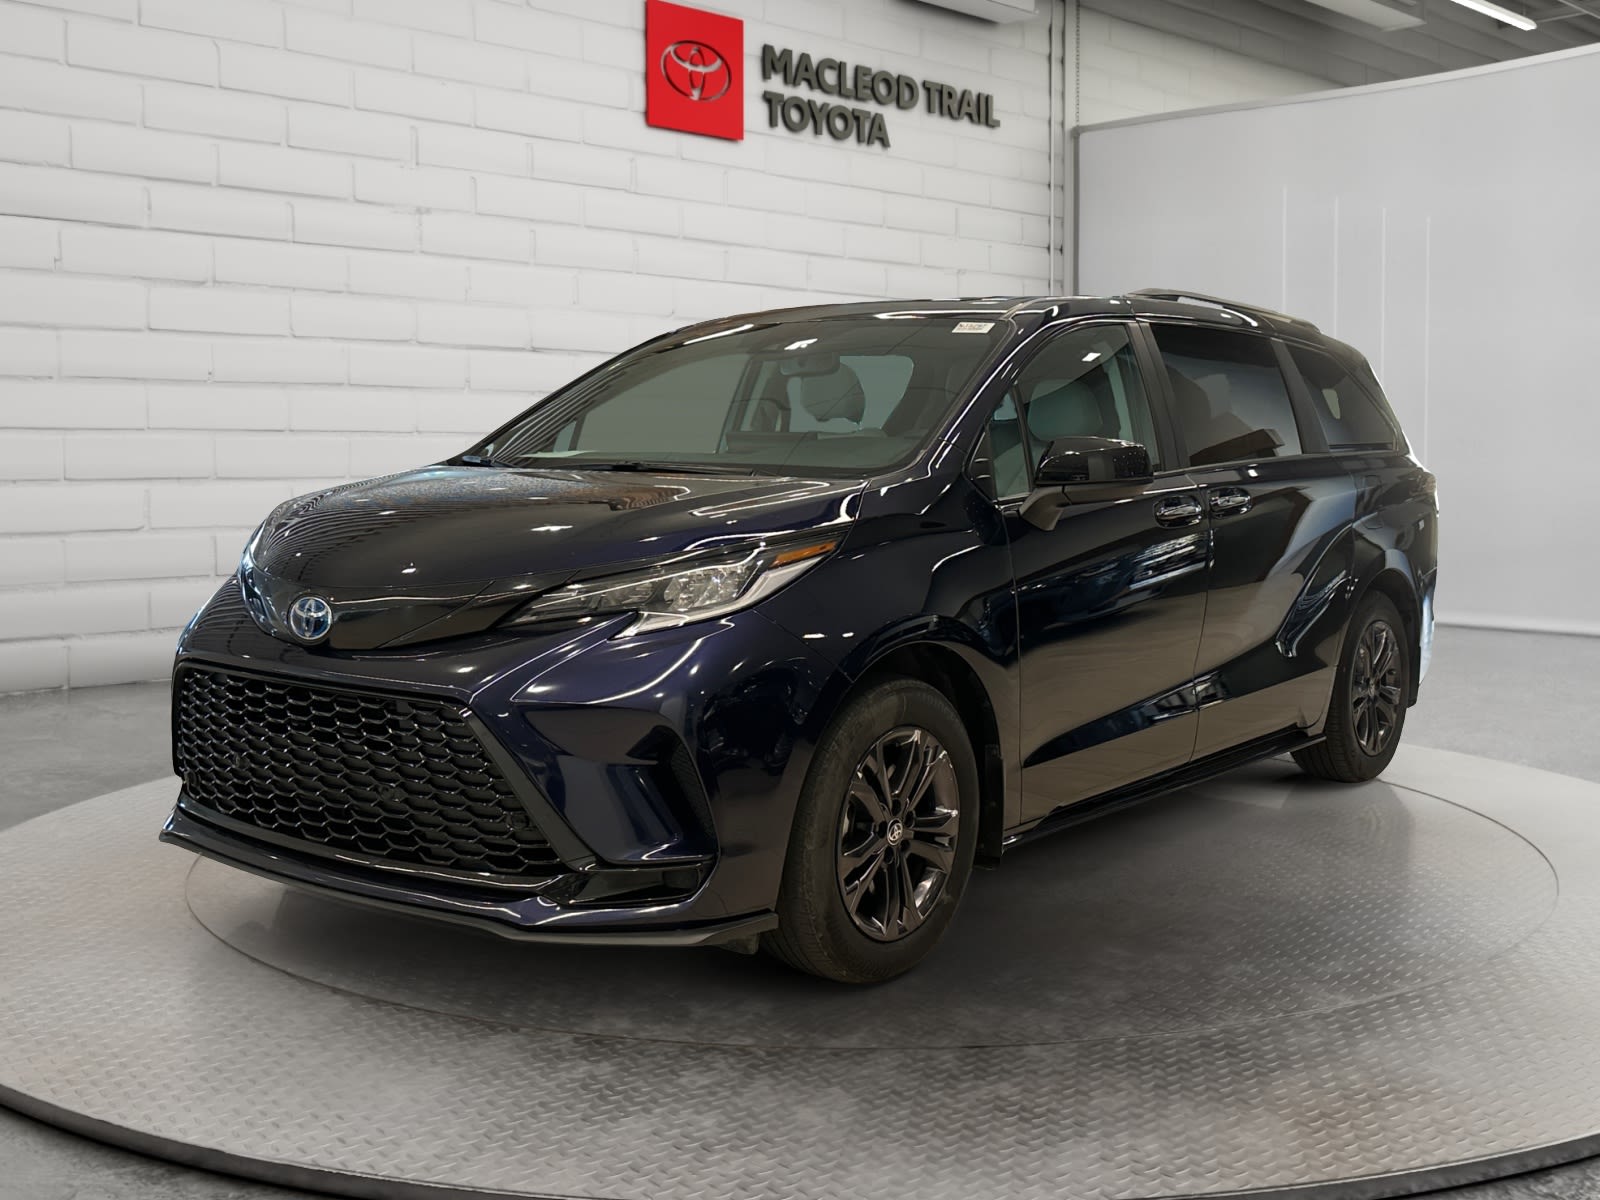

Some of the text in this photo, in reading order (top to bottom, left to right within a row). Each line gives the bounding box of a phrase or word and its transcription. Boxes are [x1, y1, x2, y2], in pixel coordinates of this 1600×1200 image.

[762, 44, 1001, 128] MACLEOD TRAIL
[762, 90, 891, 149] TOYOTA
